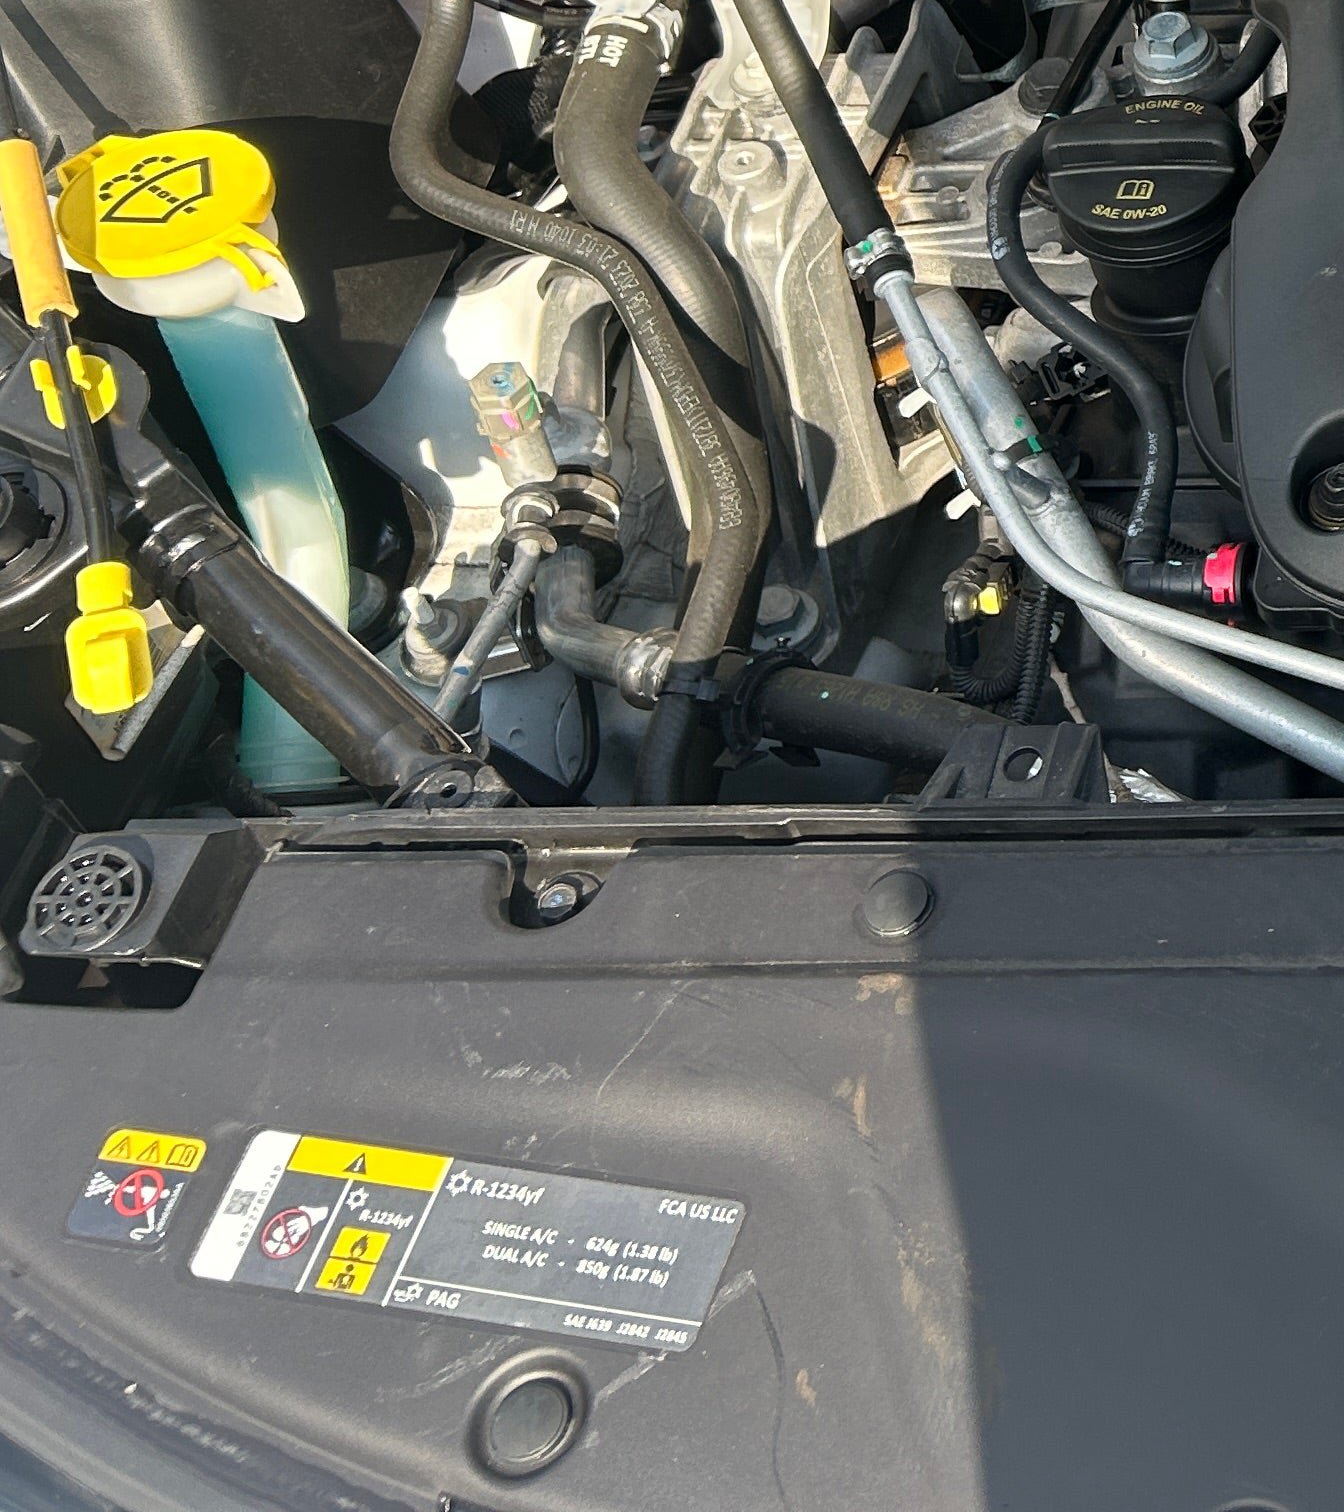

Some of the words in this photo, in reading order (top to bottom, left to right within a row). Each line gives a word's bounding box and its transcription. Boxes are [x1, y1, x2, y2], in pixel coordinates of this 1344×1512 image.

[599, 34, 628, 68] HOT
[1125, 99, 1182, 115] ENGINE
[1183, 101, 1206, 116] OIL
[1091, 203, 1122, 220] SAE
[1122, 203, 1167, 220] 0W-20
[470, 1178, 545, 1207] R-1234yf
[359, 1208, 415, 1230] R-1234yf
[658, 1198, 687, 1219] FCA
[689, 1202, 711, 1221] US
[711, 1205, 740, 1224] LLC
[482, 1220, 531, 1241] SINGLE
[530, 1225, 559, 1246] A/C
[657, 1245, 679, 1266] lb)
[482, 1244, 520, 1264] DUAL
[519, 1249, 549, 1268] A/C
[648, 1268, 670, 1288] lb)
[425, 1289, 461, 1310] PAG
[563, 1313, 586, 1329] SAE
